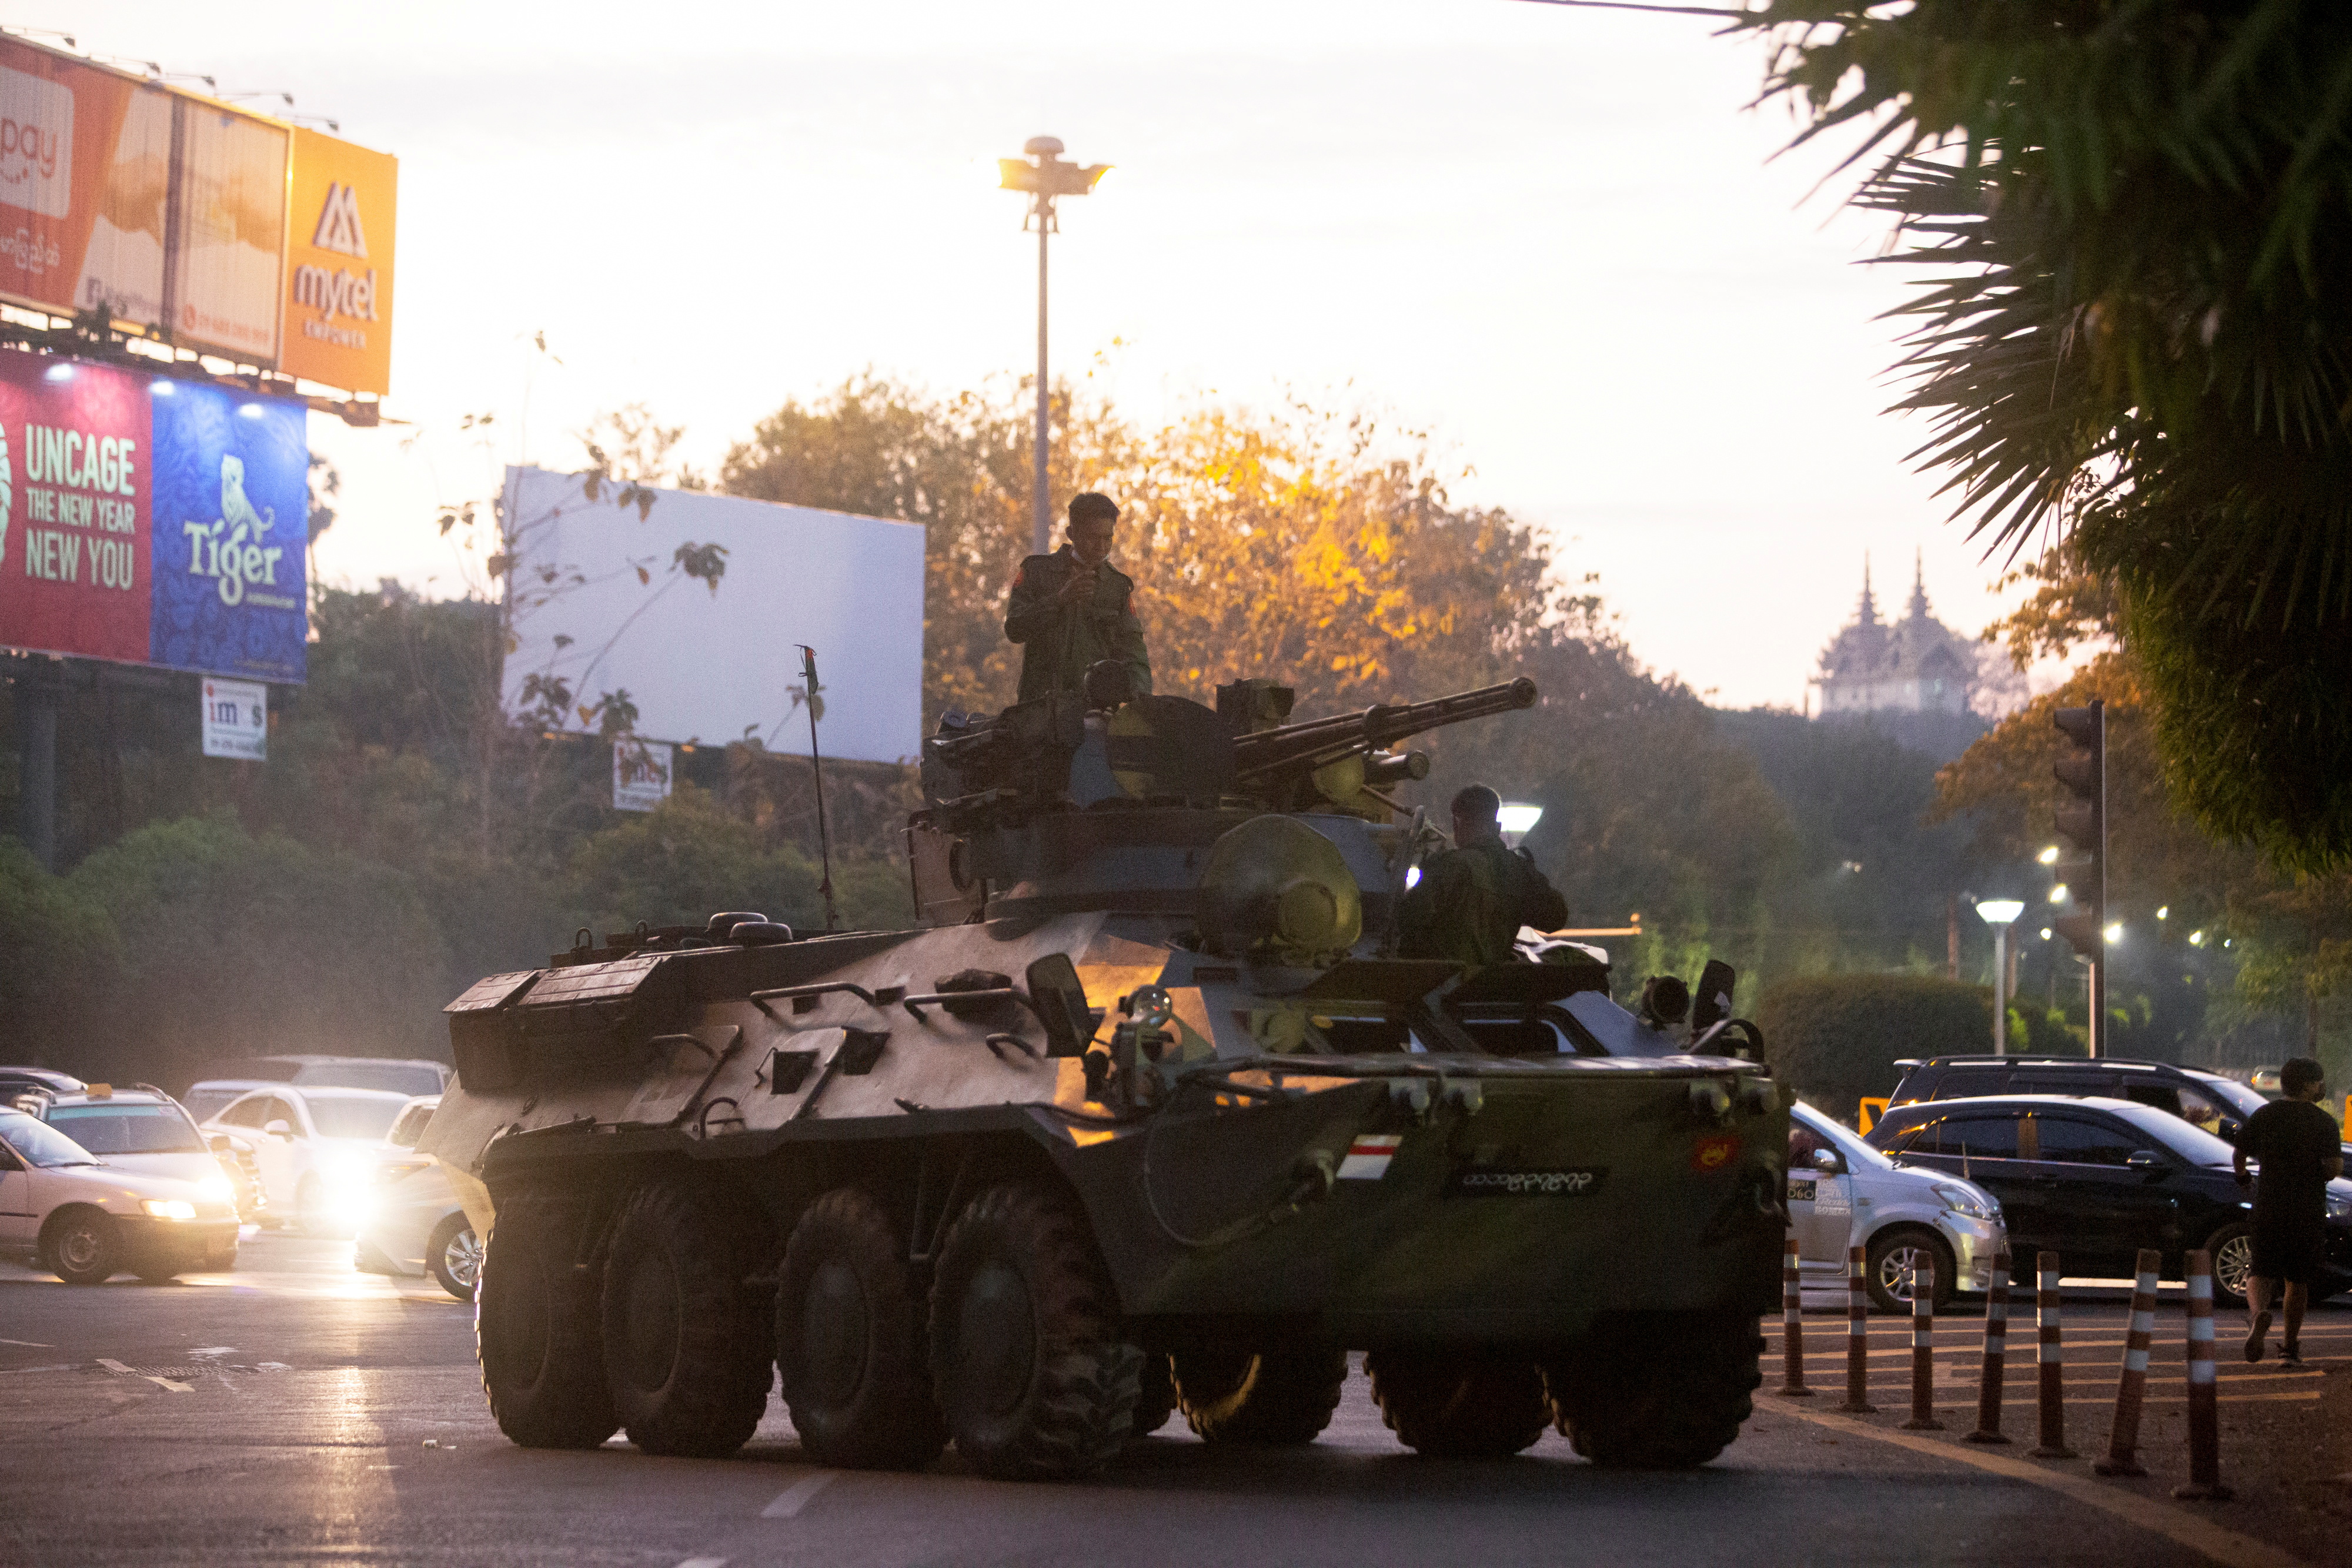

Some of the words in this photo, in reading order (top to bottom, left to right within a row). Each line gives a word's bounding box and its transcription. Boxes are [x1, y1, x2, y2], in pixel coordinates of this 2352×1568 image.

[294, 265, 377, 322] mytel
[26, 423, 135, 496] UNCAGE
[26, 487, 55, 522] THE
[59, 492, 93, 527] NEW
[97, 497, 135, 534] YEAR
[26, 528, 81, 582] NEW
[88, 535, 133, 590] YOU
[184, 518, 283, 606] Tiger
